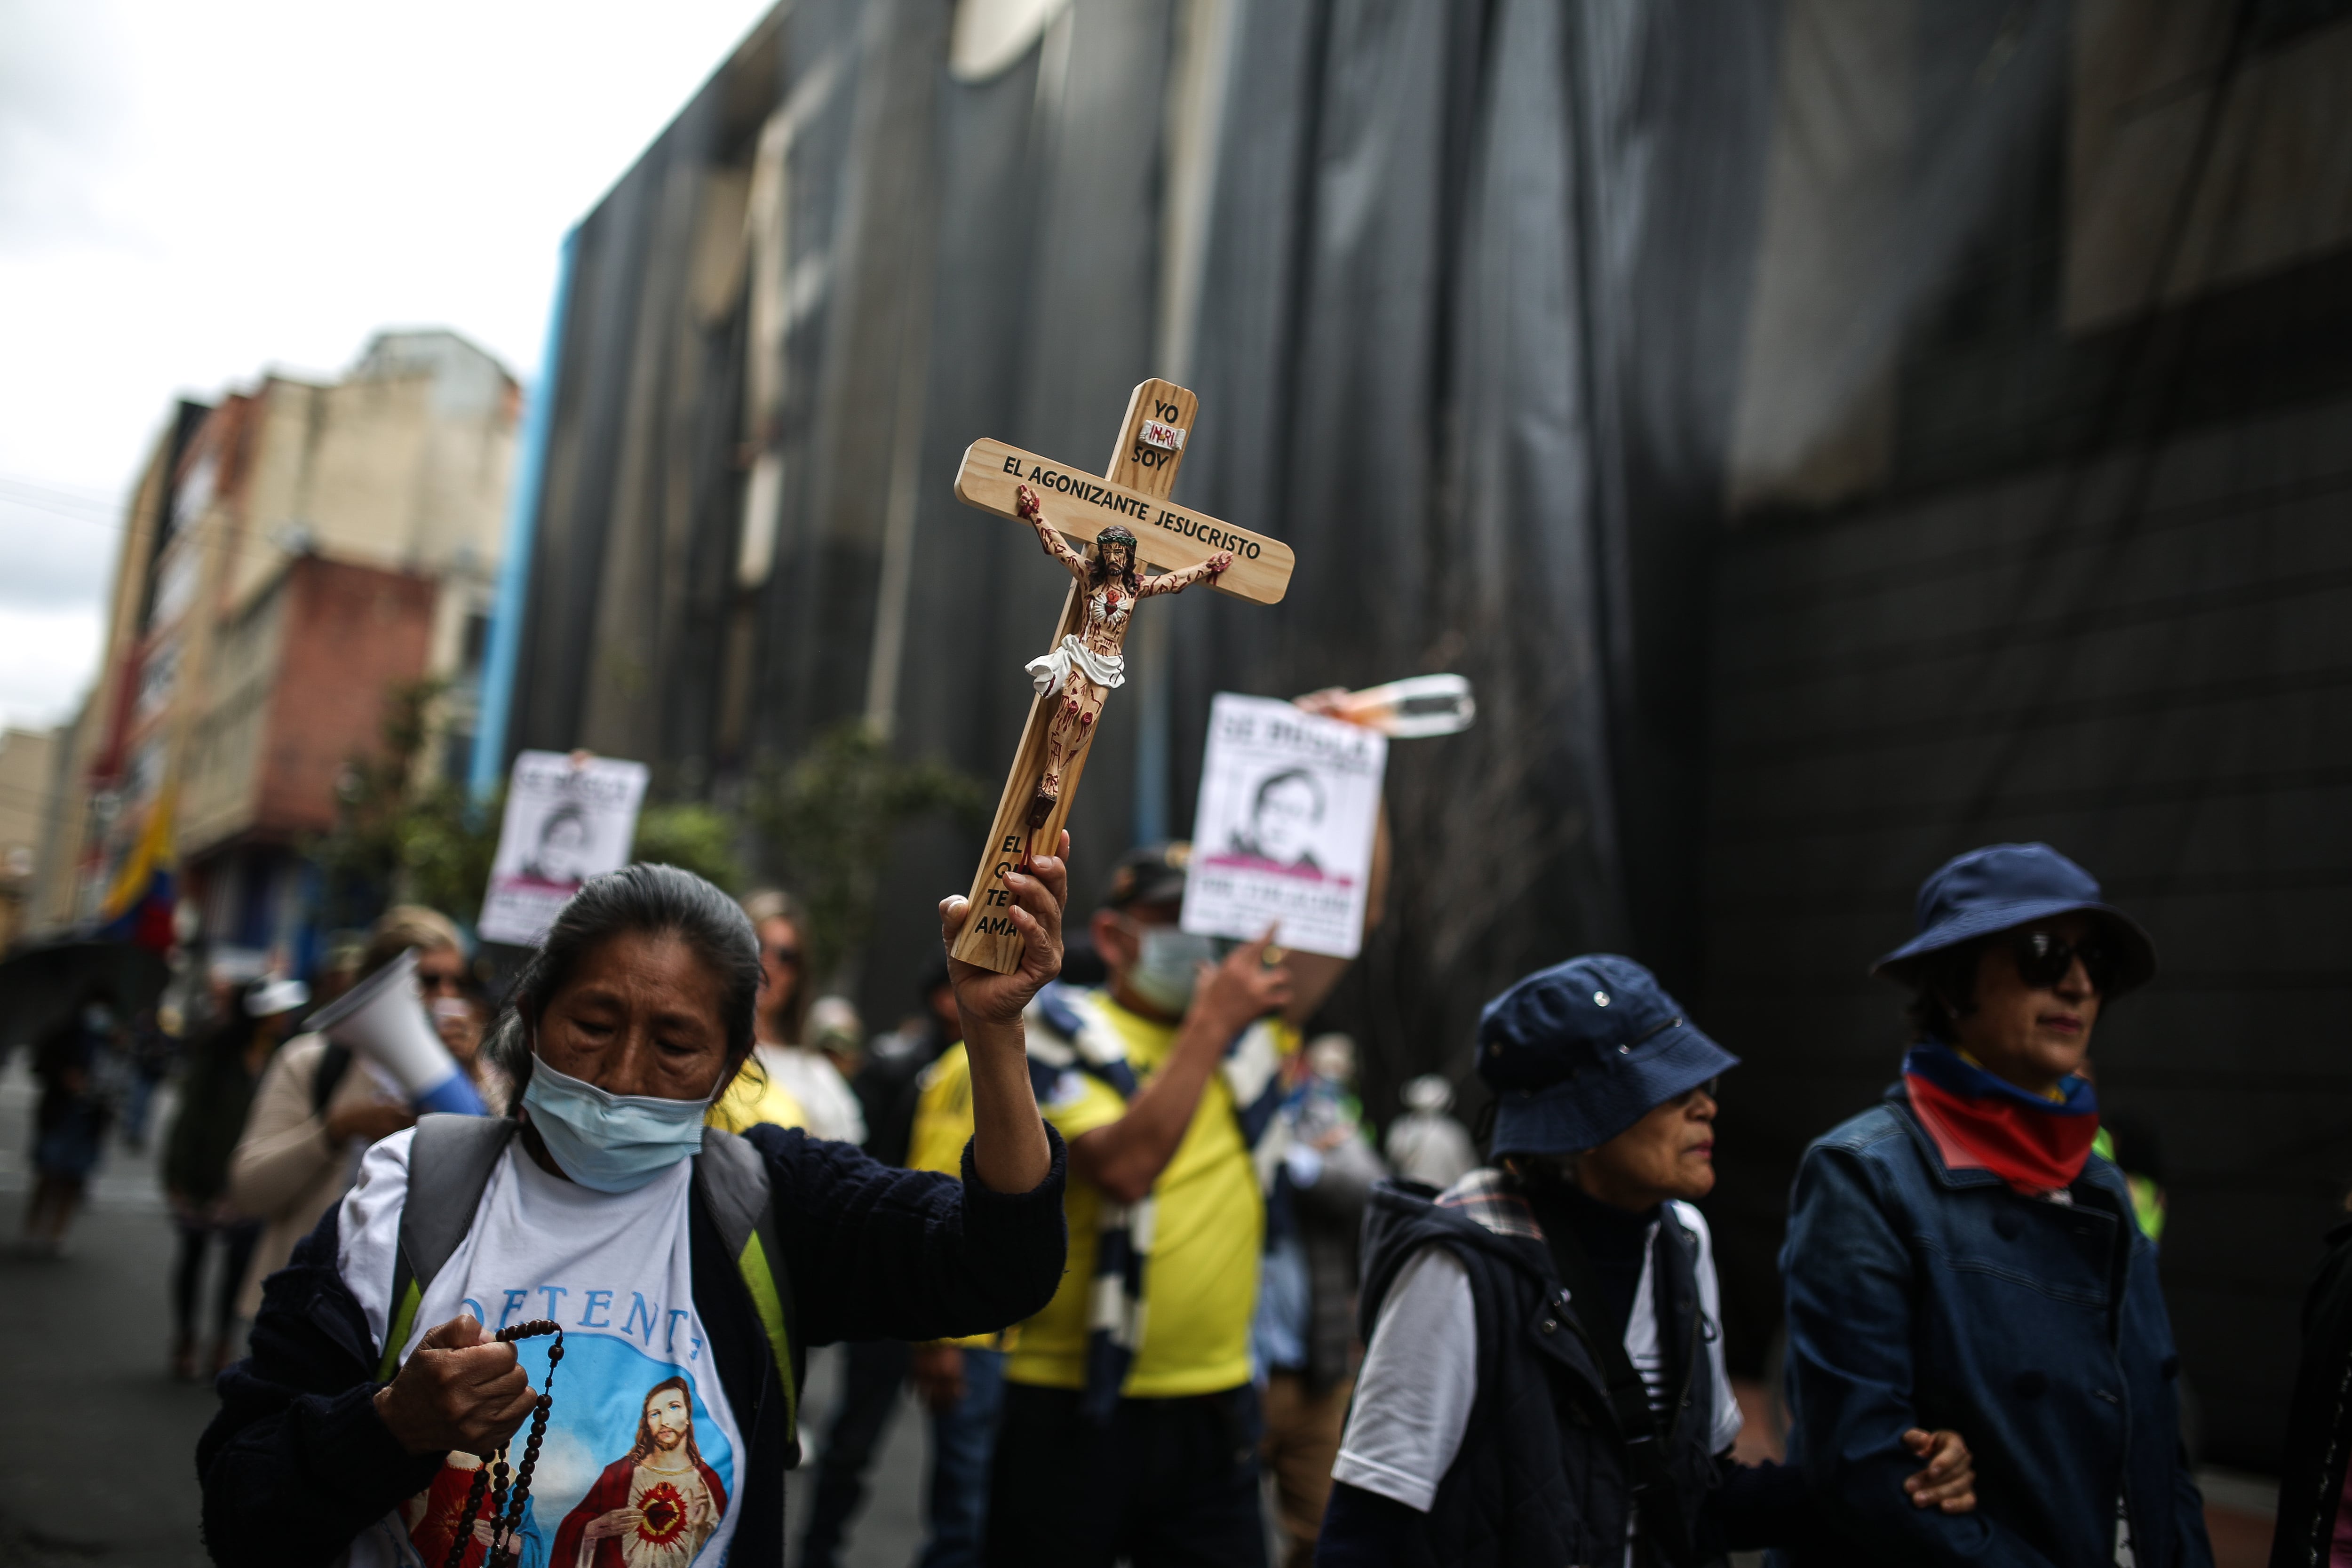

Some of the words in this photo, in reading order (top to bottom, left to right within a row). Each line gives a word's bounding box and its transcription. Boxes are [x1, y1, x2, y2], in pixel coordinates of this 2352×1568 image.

[1155, 399, 1178, 423] YO
[1131, 446, 1169, 471] SOY
[1003, 456, 1023, 478] EL
[1028, 466, 1150, 521] AGONIZANTE
[1154, 510, 1261, 559] JESUCRISTO
[1001, 836, 1022, 853] EL
[987, 889, 1009, 907] TE
[974, 916, 1017, 937] AMA
[461, 1285, 700, 1360] ETENT
